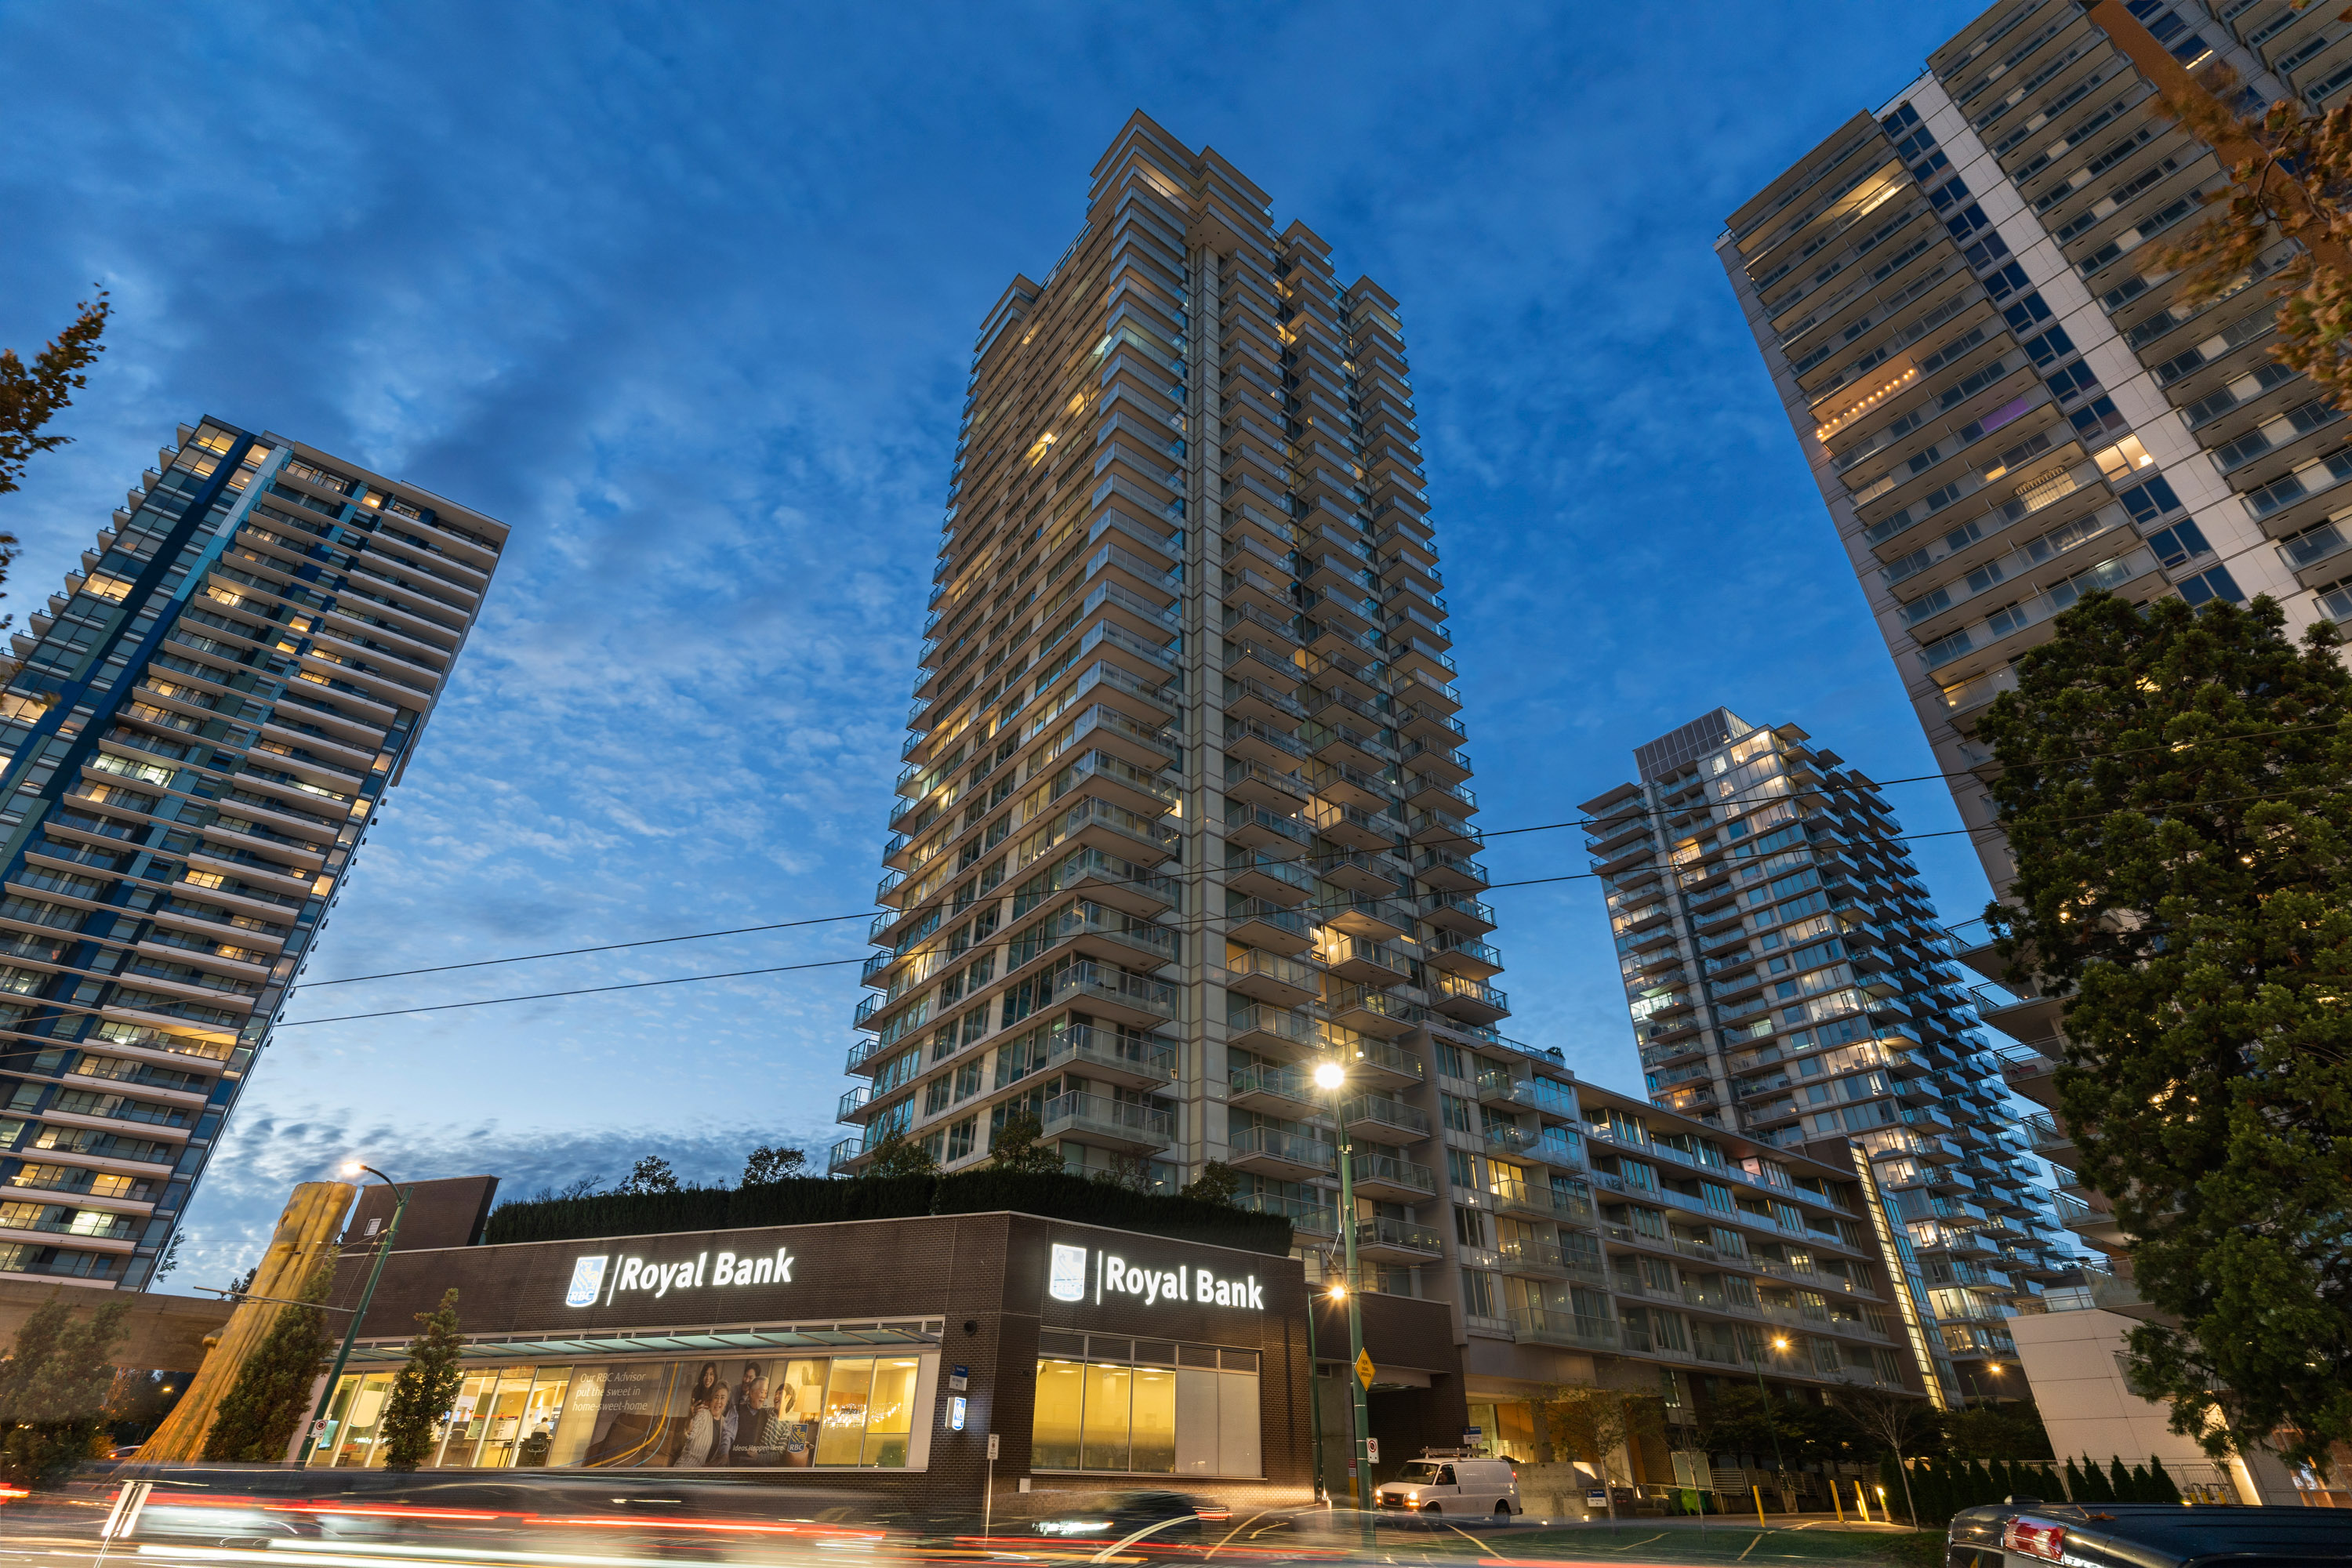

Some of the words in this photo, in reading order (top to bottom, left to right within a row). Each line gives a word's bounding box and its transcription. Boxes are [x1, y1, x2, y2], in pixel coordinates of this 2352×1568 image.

[619, 1251, 707, 1298] Royal
[712, 1247, 794, 1286] Bank
[1106, 1256, 1189, 1305] Royal
[1197, 1269, 1264, 1309] Bank
[570, 1290, 594, 1301] RBC
[580, 1373, 596, 1383] Our
[596, 1372, 614, 1382] RBC
[614, 1371, 646, 1382] Advisor
[575, 1387, 590, 1399] put
[591, 1385, 604, 1396] the
[606, 1386, 632, 1396] sweet
[632, 1386, 641, 1396] in
[572, 1400, 648, 1411] home-sweet-home
[748, 1444, 769, 1454] Happen
